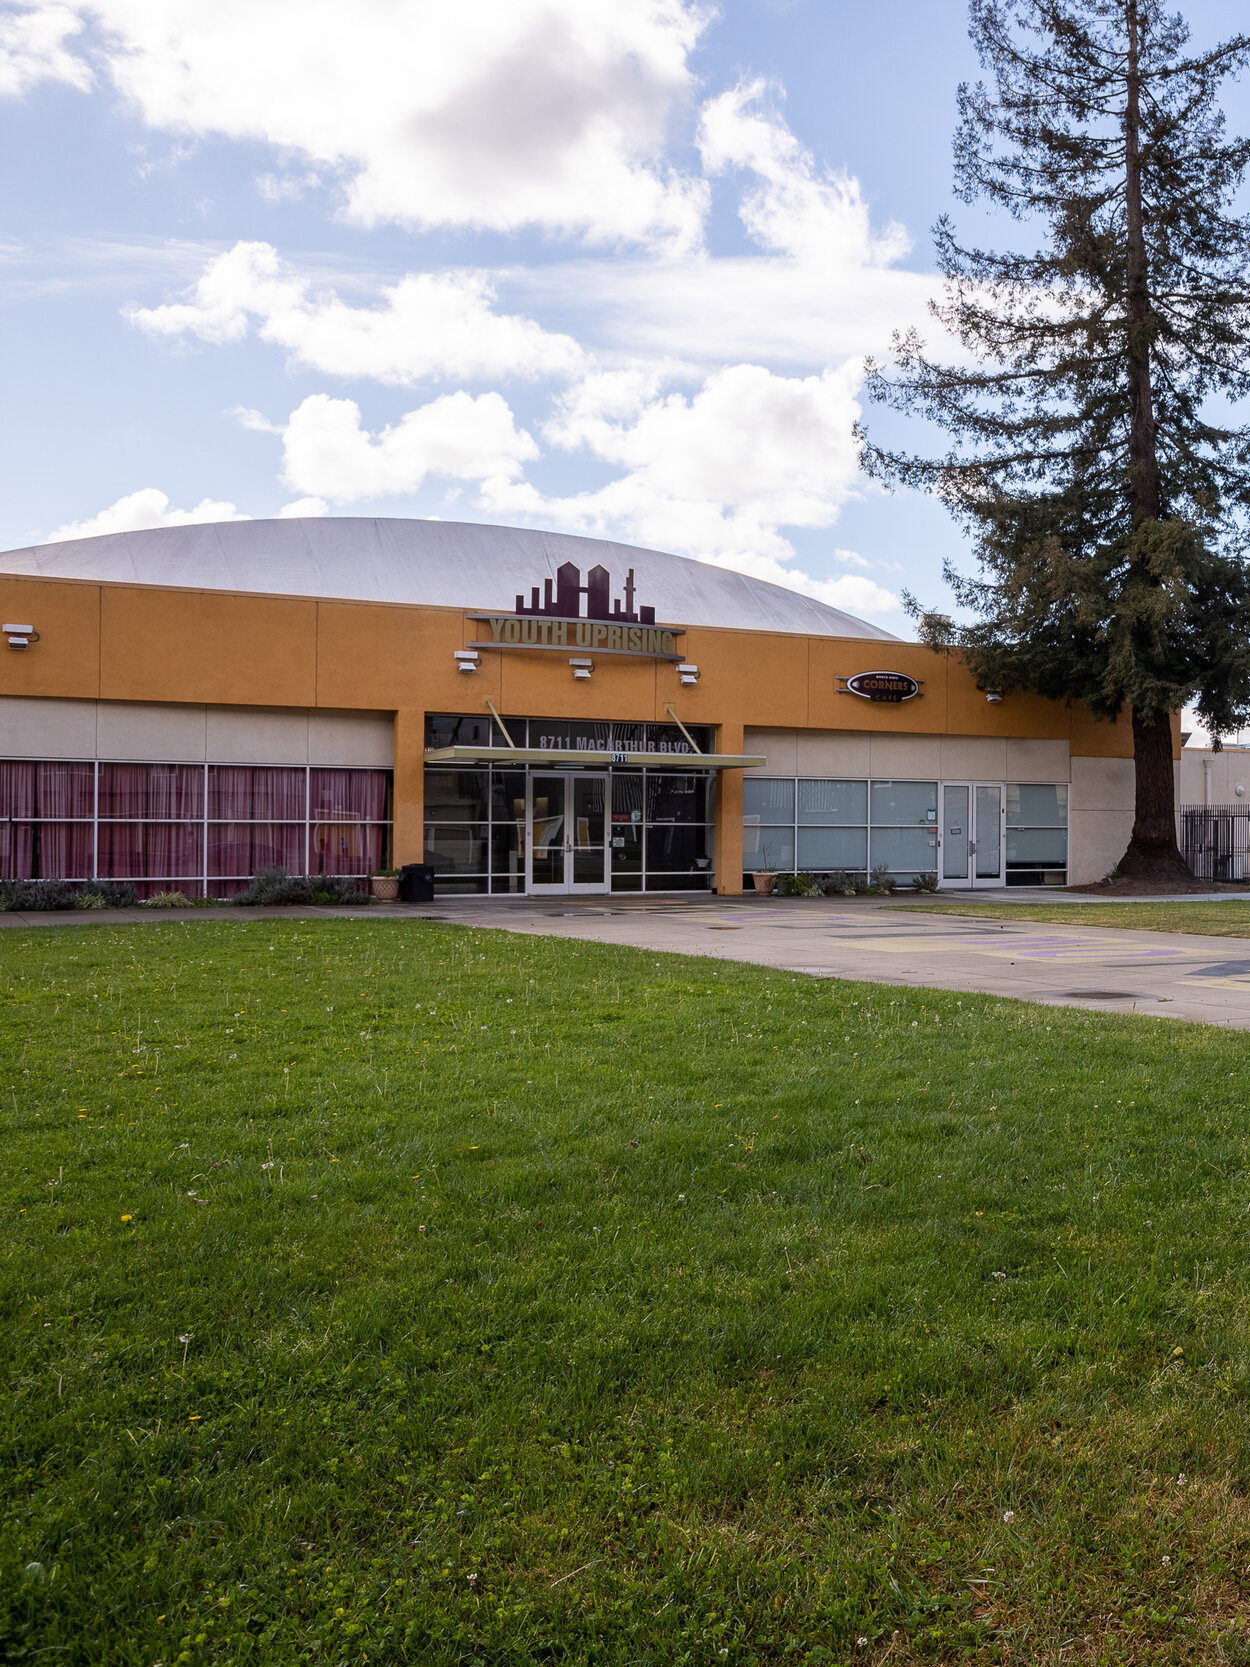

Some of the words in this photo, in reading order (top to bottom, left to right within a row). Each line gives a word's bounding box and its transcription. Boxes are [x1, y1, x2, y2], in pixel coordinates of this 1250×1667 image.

[489, 617, 568, 646] YOUTH
[575, 621, 674, 654] UPRISING
[863, 679, 908, 692] CORNERS
[539, 736, 571, 750] 8711
[611, 753, 628, 762] 8711
